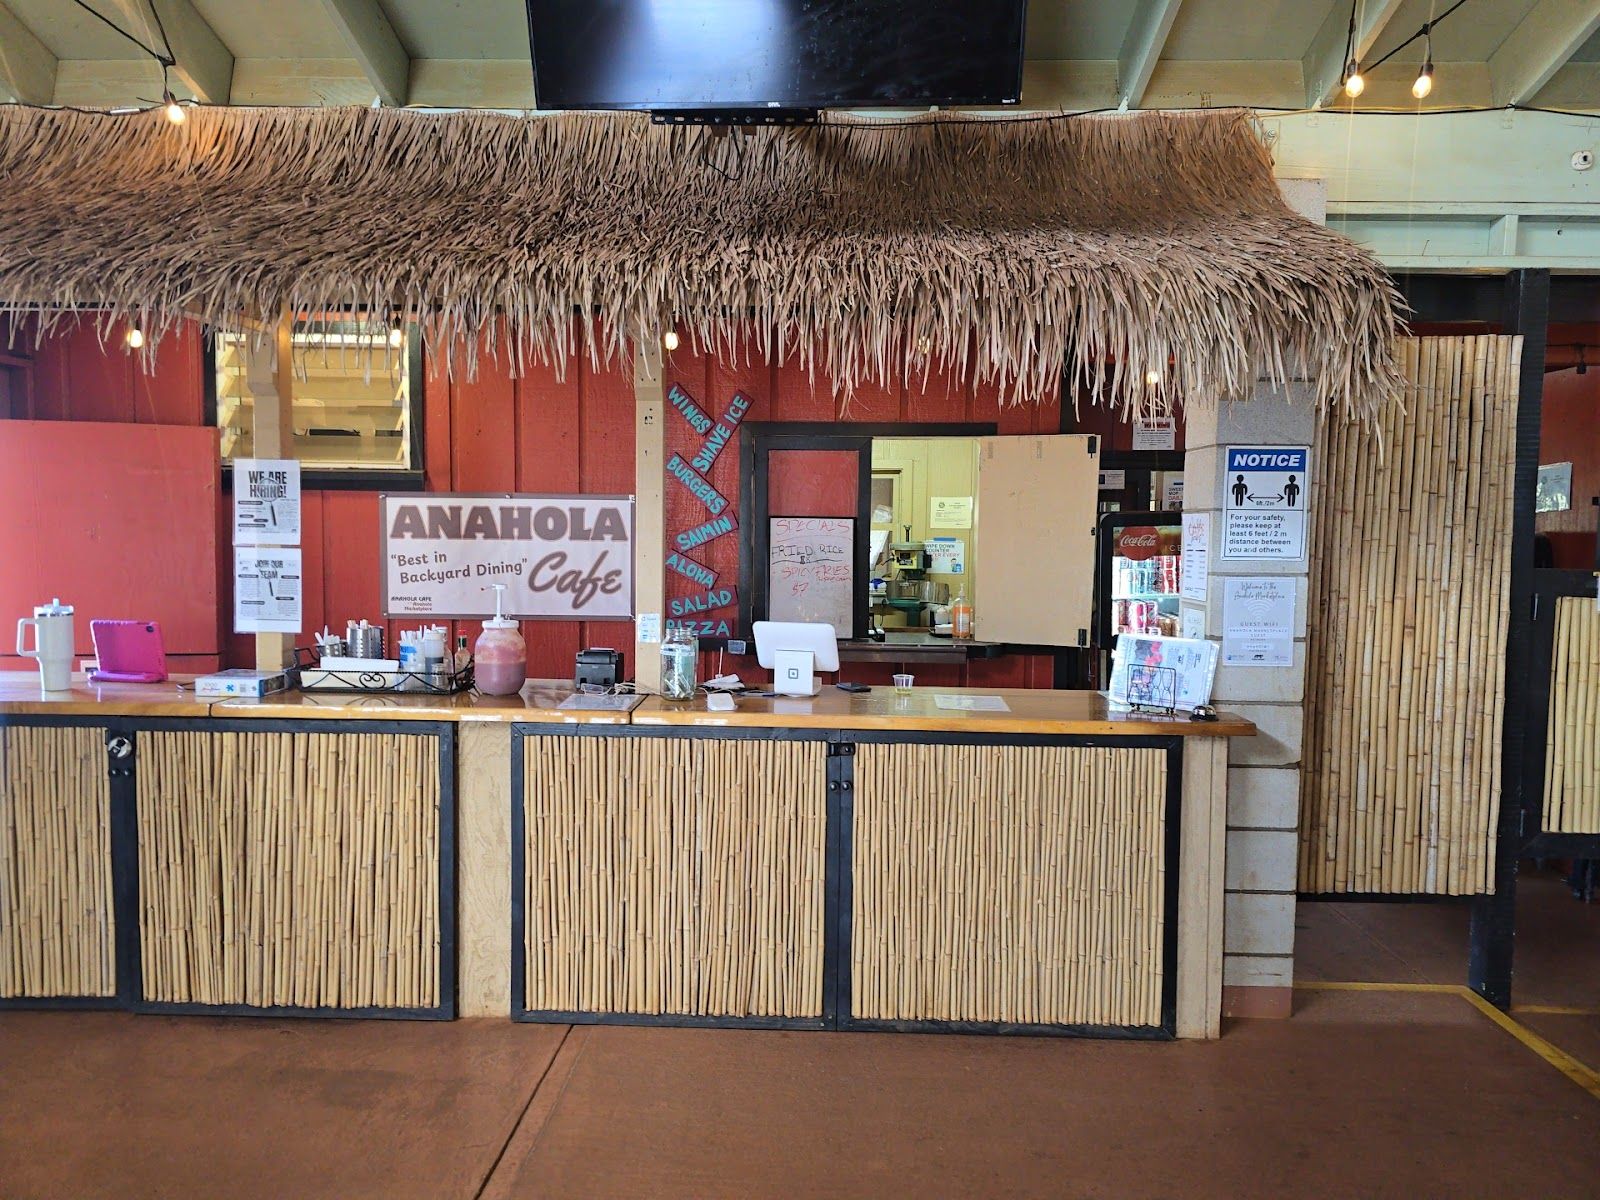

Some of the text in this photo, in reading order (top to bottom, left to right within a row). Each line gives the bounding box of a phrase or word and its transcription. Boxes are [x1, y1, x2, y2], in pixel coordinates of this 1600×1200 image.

[668, 386, 711, 434] WINGS
[692, 395, 748, 472] SHAVE ICE
[1233, 454, 1301, 467] NOTICE
[248, 471, 287, 485] WE ARE
[667, 456, 724, 514] BURGERS
[249, 485, 287, 498] HIRING!
[390, 504, 628, 542] ANAHOLA
[776, 519, 849, 535] SPECIALS
[677, 515, 732, 550] SAIMIN
[391, 551, 447, 567] “Best in
[771, 544, 844, 558] FRIED RICE
[260, 571, 278, 579] TEAM
[400, 558, 528, 584] Backyard Dining”
[666, 553, 714, 590] ALOHA
[783, 566, 815, 579] SPICY
[816, 565, 850, 576] FRIES
[528, 550, 622, 610] Cafe
[792, 582, 809, 596] $7
[672, 590, 732, 616] SALAD
[666, 619, 730, 636] PIZZA
